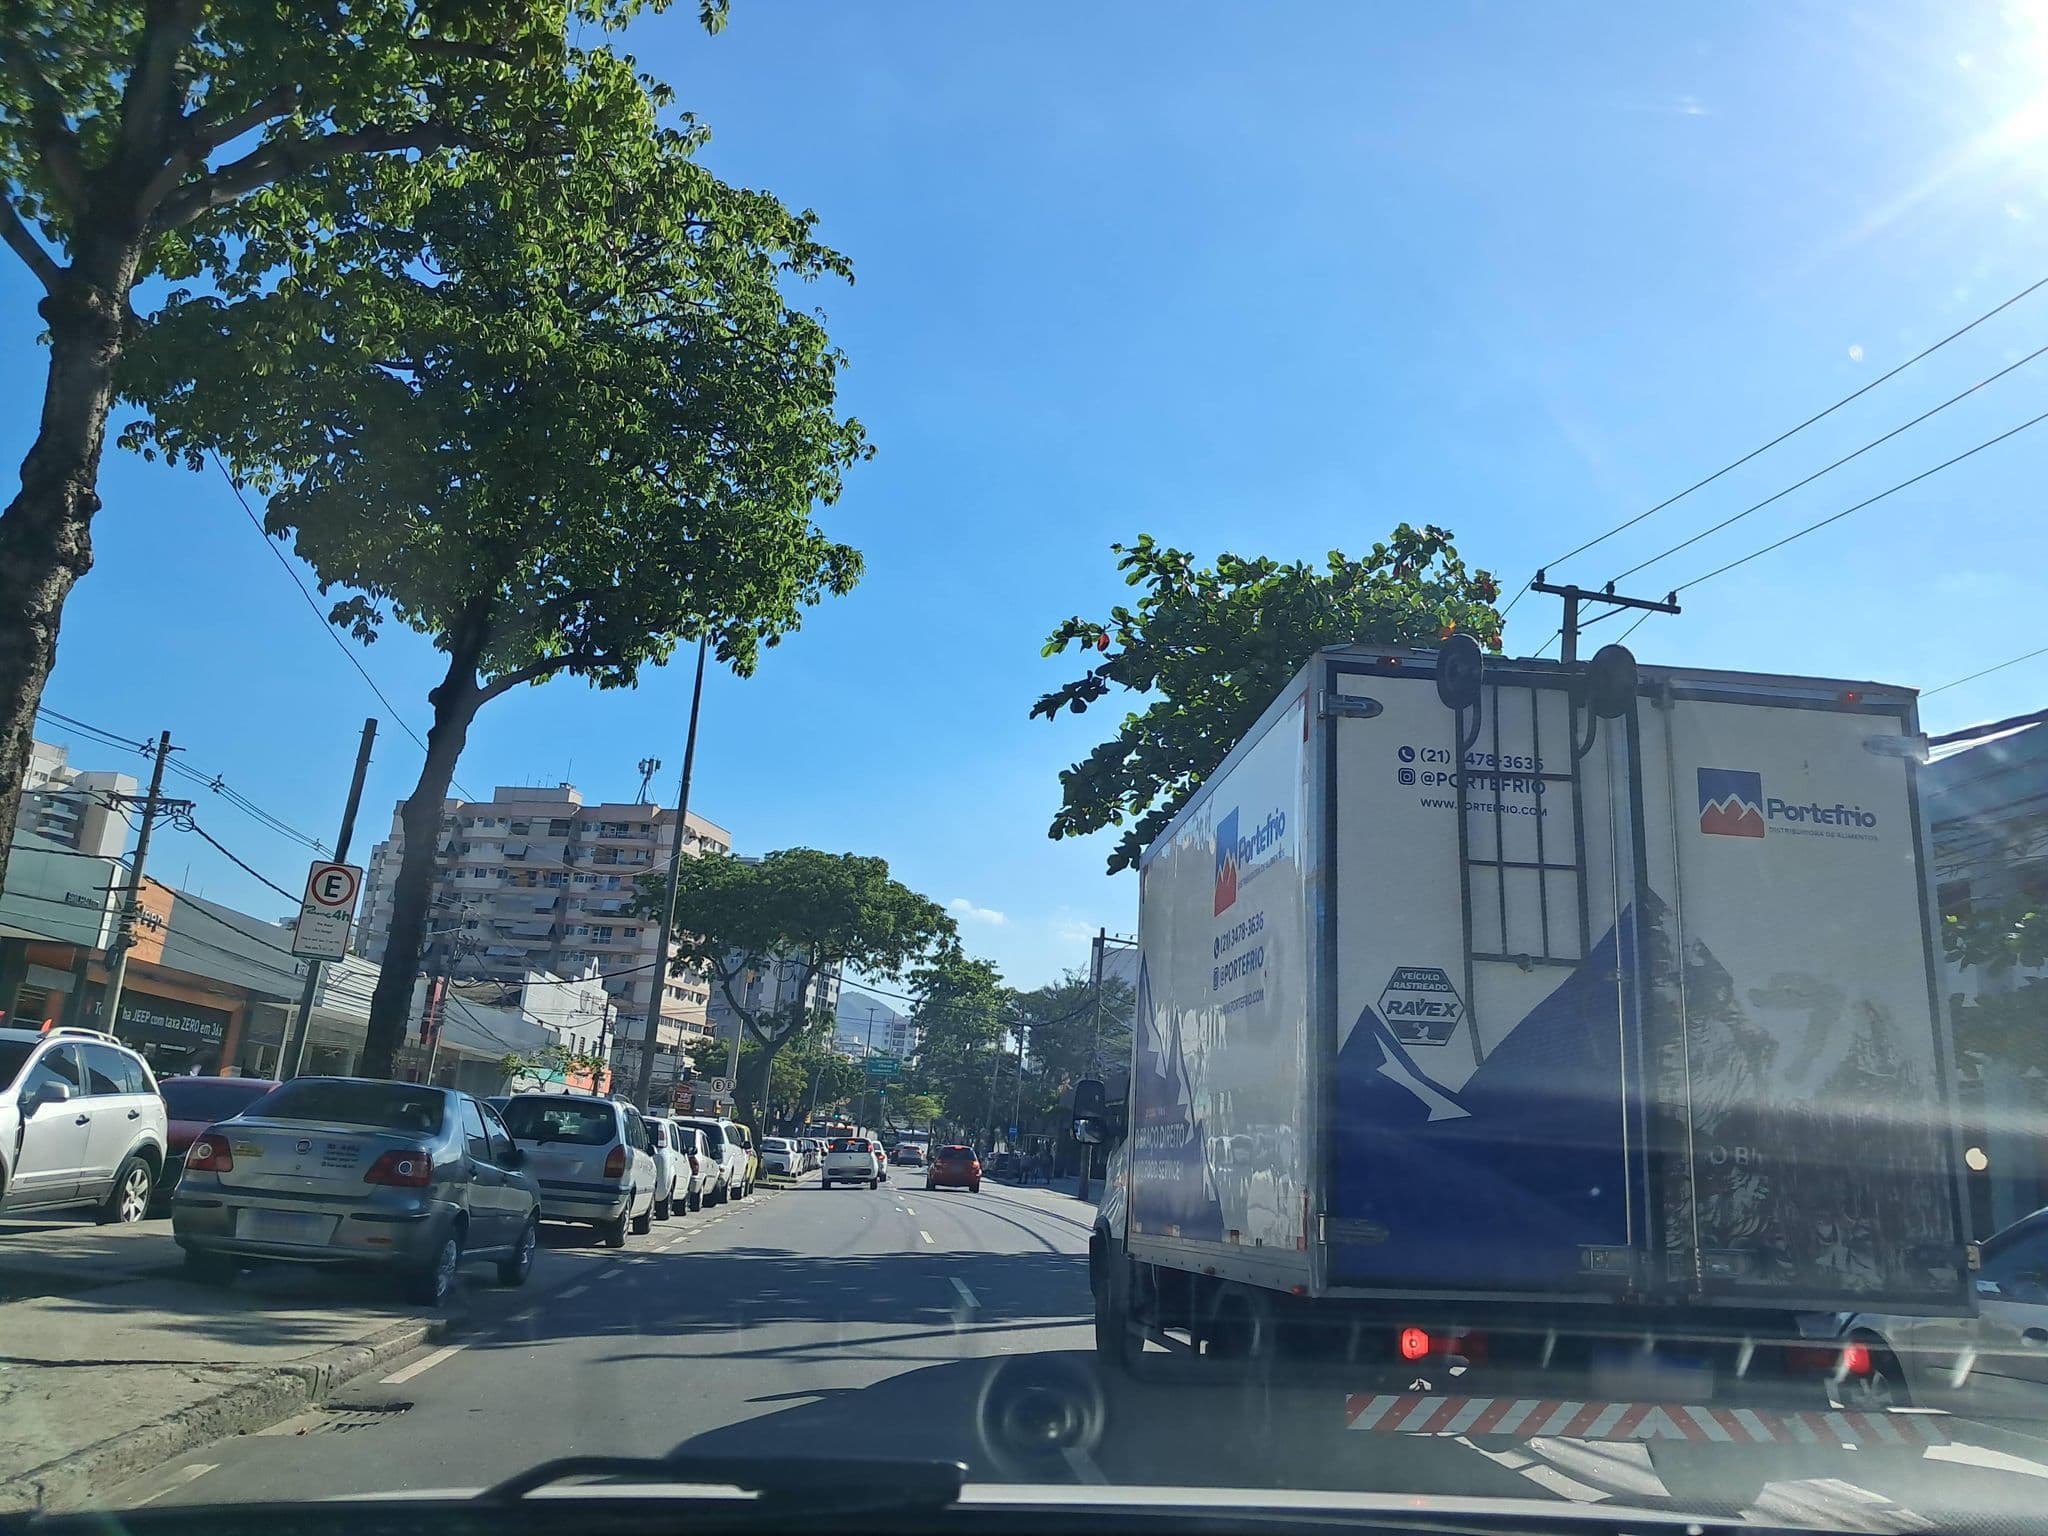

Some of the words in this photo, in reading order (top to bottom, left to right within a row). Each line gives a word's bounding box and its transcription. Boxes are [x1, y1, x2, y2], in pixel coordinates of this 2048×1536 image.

[1420, 747, 1450, 764] (21)
[1767, 798, 1877, 828] Portefrio
[1238, 807, 1286, 869] Portefrio
[324, 875, 342, 898] E
[1393, 981, 1448, 991] RASTREADO
[1386, 998, 1458, 1017] RAVEX
[133, 1008, 150, 1023] JEEP
[150, 1014, 165, 1026] com
[165, 1016, 180, 1030] taxa
[181, 1017, 200, 1033] ZERO
[200, 1023, 211, 1035] em
